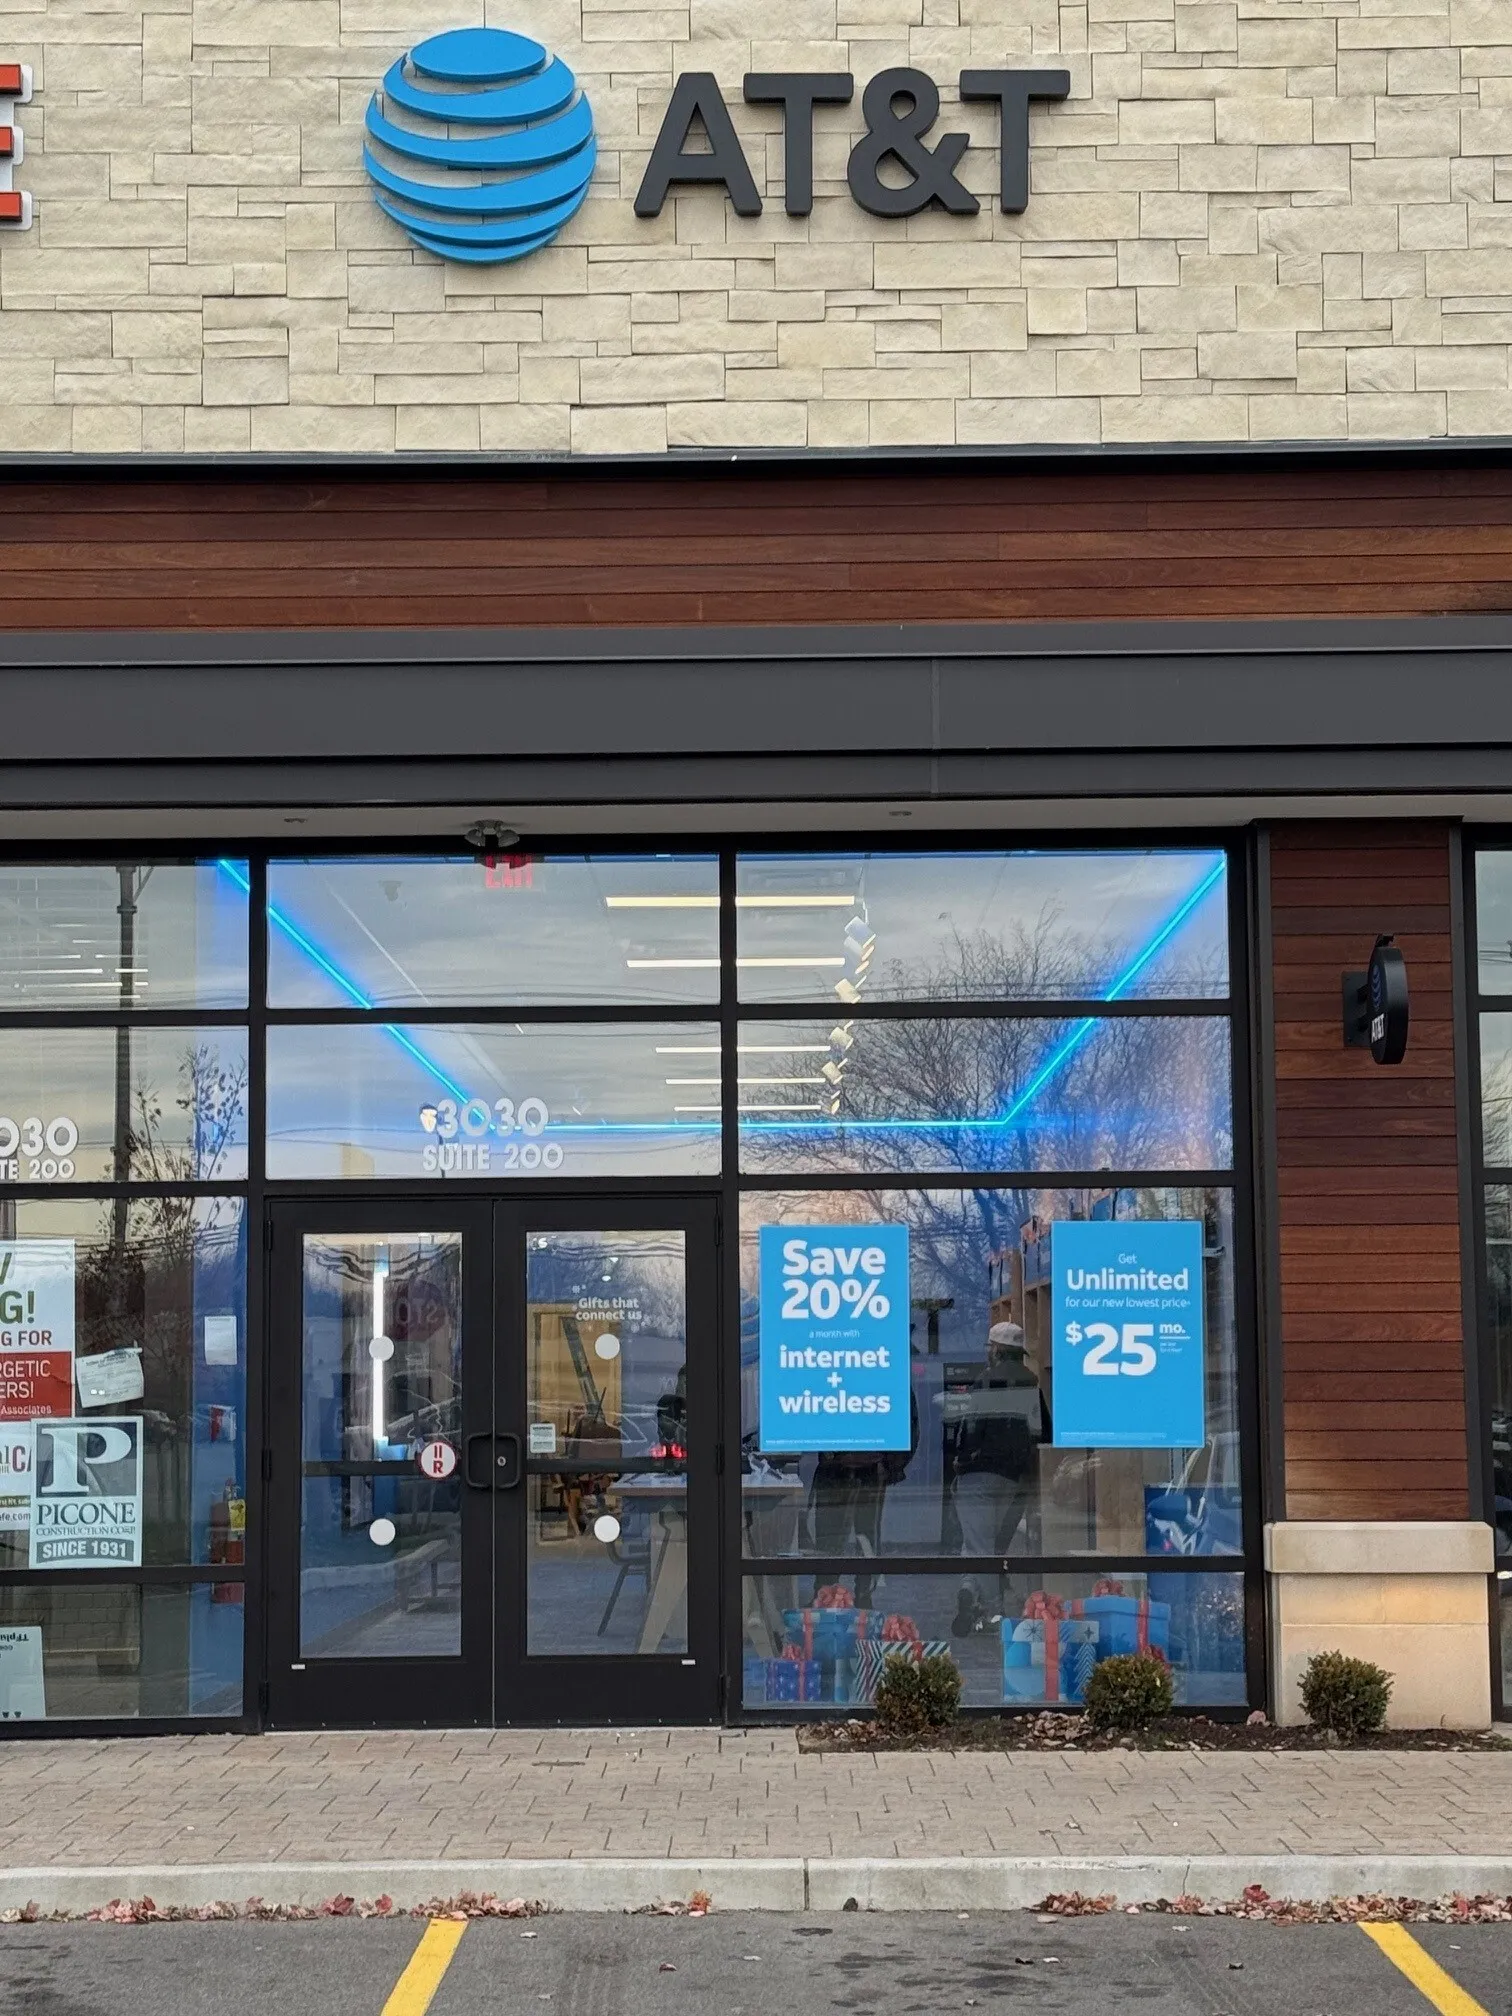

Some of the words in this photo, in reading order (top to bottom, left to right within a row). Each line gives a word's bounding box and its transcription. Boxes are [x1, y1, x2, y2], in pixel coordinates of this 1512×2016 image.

[634, 66, 1070, 217] AT&T
[1371, 1013, 1385, 1043] AT&T
[436, 1097, 549, 1138] 3030
[29, 1158, 76, 1179] 200
[422, 1143, 491, 1171] SUITE
[504, 1143, 564, 1170] 200
[782, 1240, 886, 1275] Save
[1118, 1253, 1138, 1265] Get
[1067, 1267, 1189, 1291] Unlimited
[578, 1296, 610, 1309] Gifts
[613, 1297, 640, 1309] that
[781, 1279, 891, 1319] 20%
[1065, 1296, 1080, 1308] for
[1082, 1298, 1100, 1308] our
[1102, 1298, 1124, 1308] new
[1125, 1297, 1160, 1308] lowest
[576, 1309, 625, 1321] connect
[628, 1311, 642, 1321] us
[18, 1330, 52, 1346] FOR
[816, 1330, 841, 1338] month
[780, 1344, 890, 1368] internet
[1065, 1320, 1157, 1376] $25
[1159, 1323, 1186, 1334] mo.
[0, 1359, 51, 1378] GETIC
[779, 1390, 891, 1414] wireless
[41, 1427, 132, 1493] P
[433, 1461, 444, 1474] R
[36, 1502, 136, 1526] PICONE
[36, 1527, 109, 1536] CONSTRUCTION
[42, 1541, 87, 1559] SINCE
[91, 1541, 126, 1558] 1931
